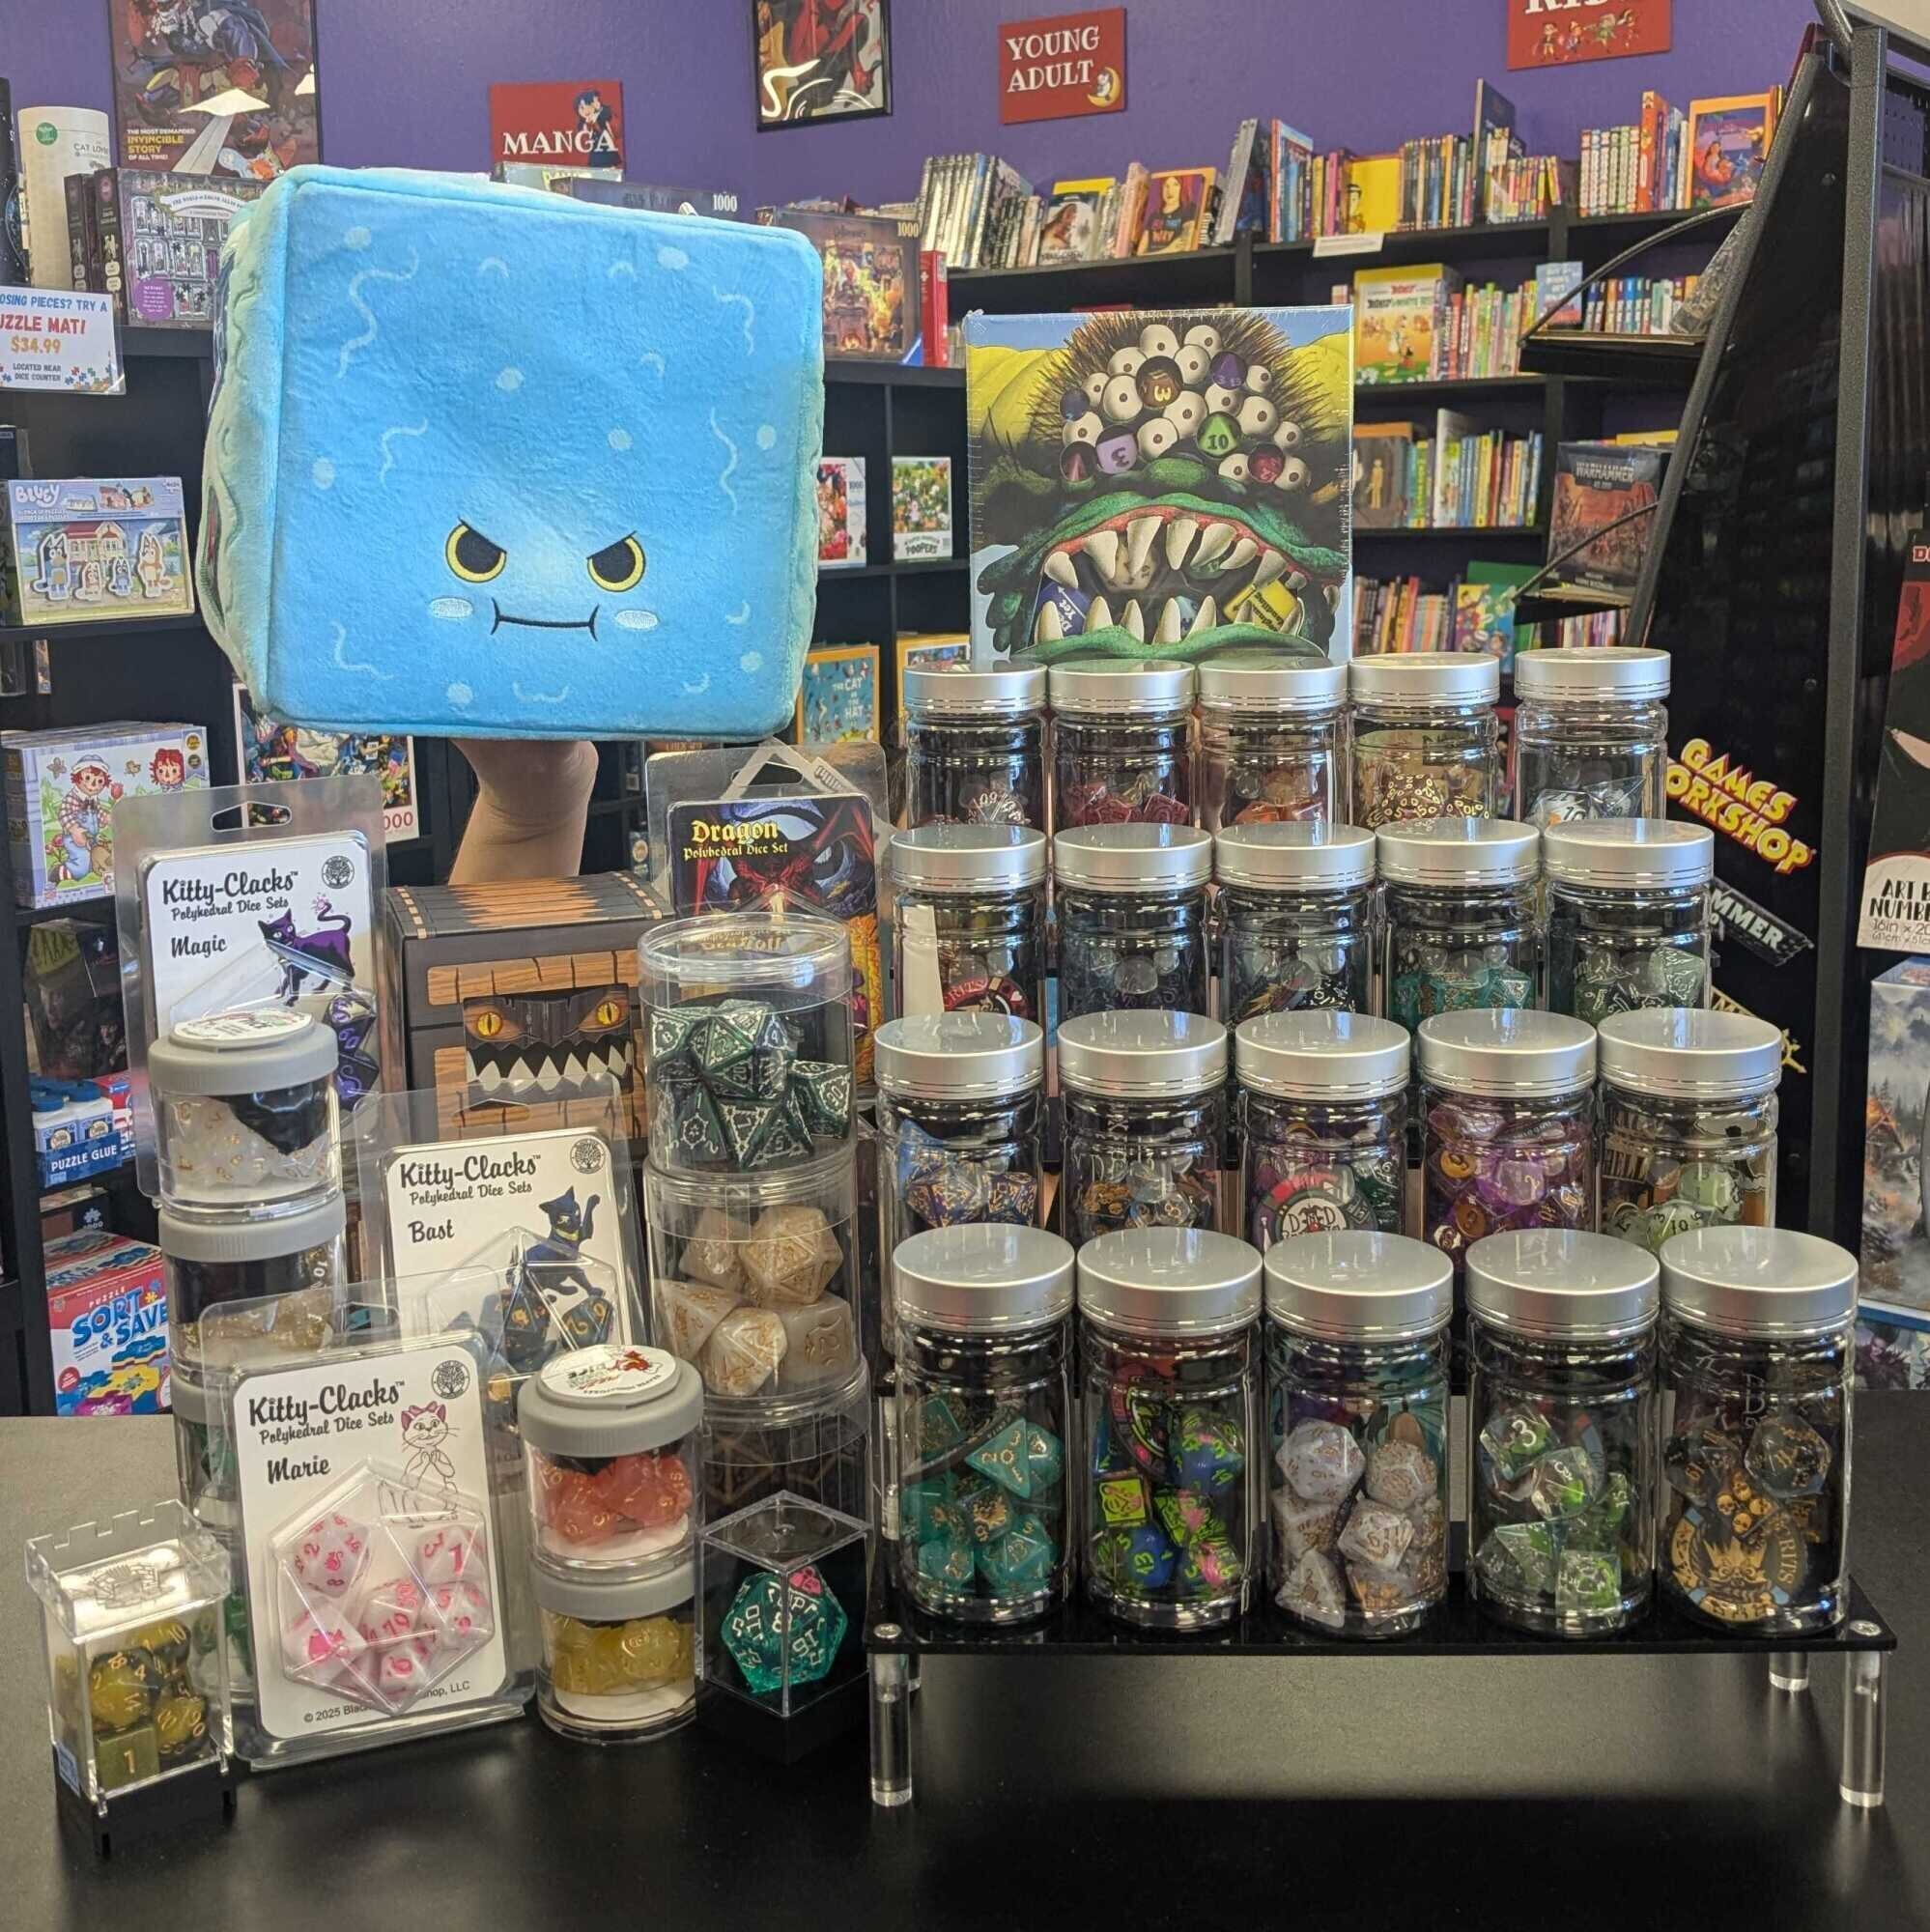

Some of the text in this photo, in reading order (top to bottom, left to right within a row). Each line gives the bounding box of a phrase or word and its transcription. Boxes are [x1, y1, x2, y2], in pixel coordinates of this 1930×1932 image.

[1007, 25, 1100, 61] YOUNG
[1007, 60, 1094, 94] ADULT
[73, 143, 90, 152] CAT
[127, 135, 184, 144] INVINCIBLE
[128, 145, 161, 155] STORY
[502, 130, 619, 156] MANGA
[713, 193, 738, 213] 1000
[896, 222, 919, 238] 1000
[0, 293, 108, 313] OSING PIECES? TRY A
[47, 317, 87, 335] MAT!
[11, 335, 62, 355] $34.99
[13, 363, 42, 373] LOCATED
[14, 373, 62, 383] DICE COUNTER
[1575, 462, 1634, 483] WARHAMMER
[845, 676, 863, 692] CAT
[844, 705, 865, 720] HAT
[1680, 737, 1799, 826] GAMES
[383, 811, 413, 831] 000
[1666, 757, 1816, 875] ORKSHOP
[690, 819, 780, 844] Dragon
[682, 841, 788, 862] Polyhedral Dice Set
[1881, 878, 1915, 899] ART
[171, 895, 289, 922] Polyhedral Dice Sets
[1869, 897, 1930, 923] NUMBE
[171, 934, 228, 958] Magic
[50, 1145, 117, 1172] PUZZLE GLUE
[410, 1181, 533, 1207] Polyhedral Dice Sets
[408, 1219, 455, 1244] Bast
[89, 1286, 127, 1308] PUZZLE
[71, 1286, 144, 1349] SORT
[99, 1296, 168, 1350] & SAVE
[259, 1410, 395, 1446] Polyhedral Dice Sets
[267, 1455, 331, 1485] Marie
[315, 1707, 341, 1722] 2025
[449, 1681, 470, 1692] LLC
